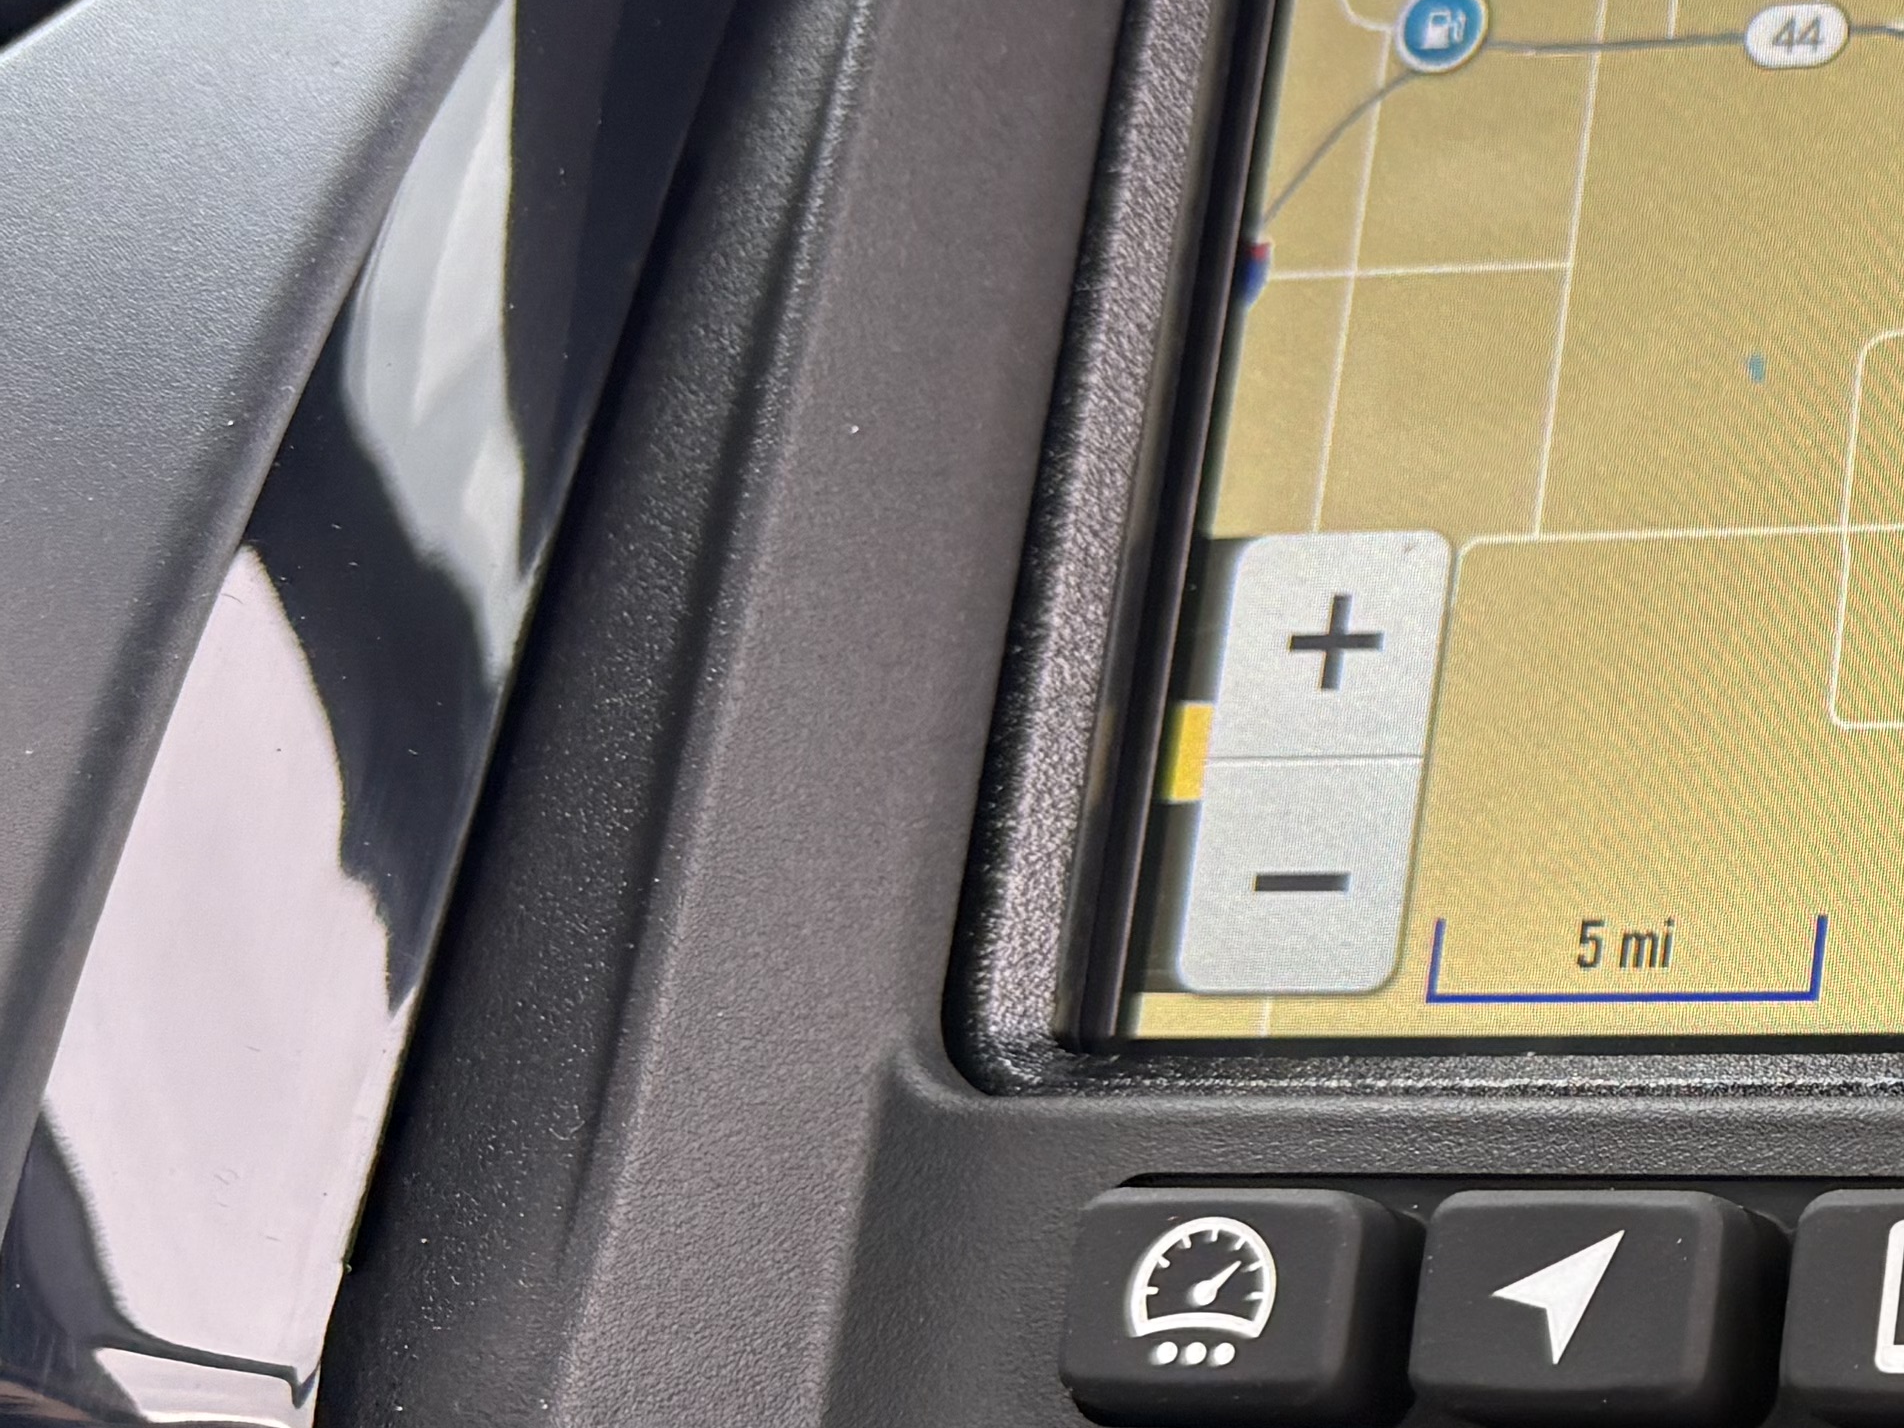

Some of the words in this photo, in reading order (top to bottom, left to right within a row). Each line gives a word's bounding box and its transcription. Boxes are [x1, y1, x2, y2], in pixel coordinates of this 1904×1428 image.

[1771, 12, 1824, 55] 44
[1576, 919, 1605, 969] 5
[1619, 916, 1676, 969] mi
